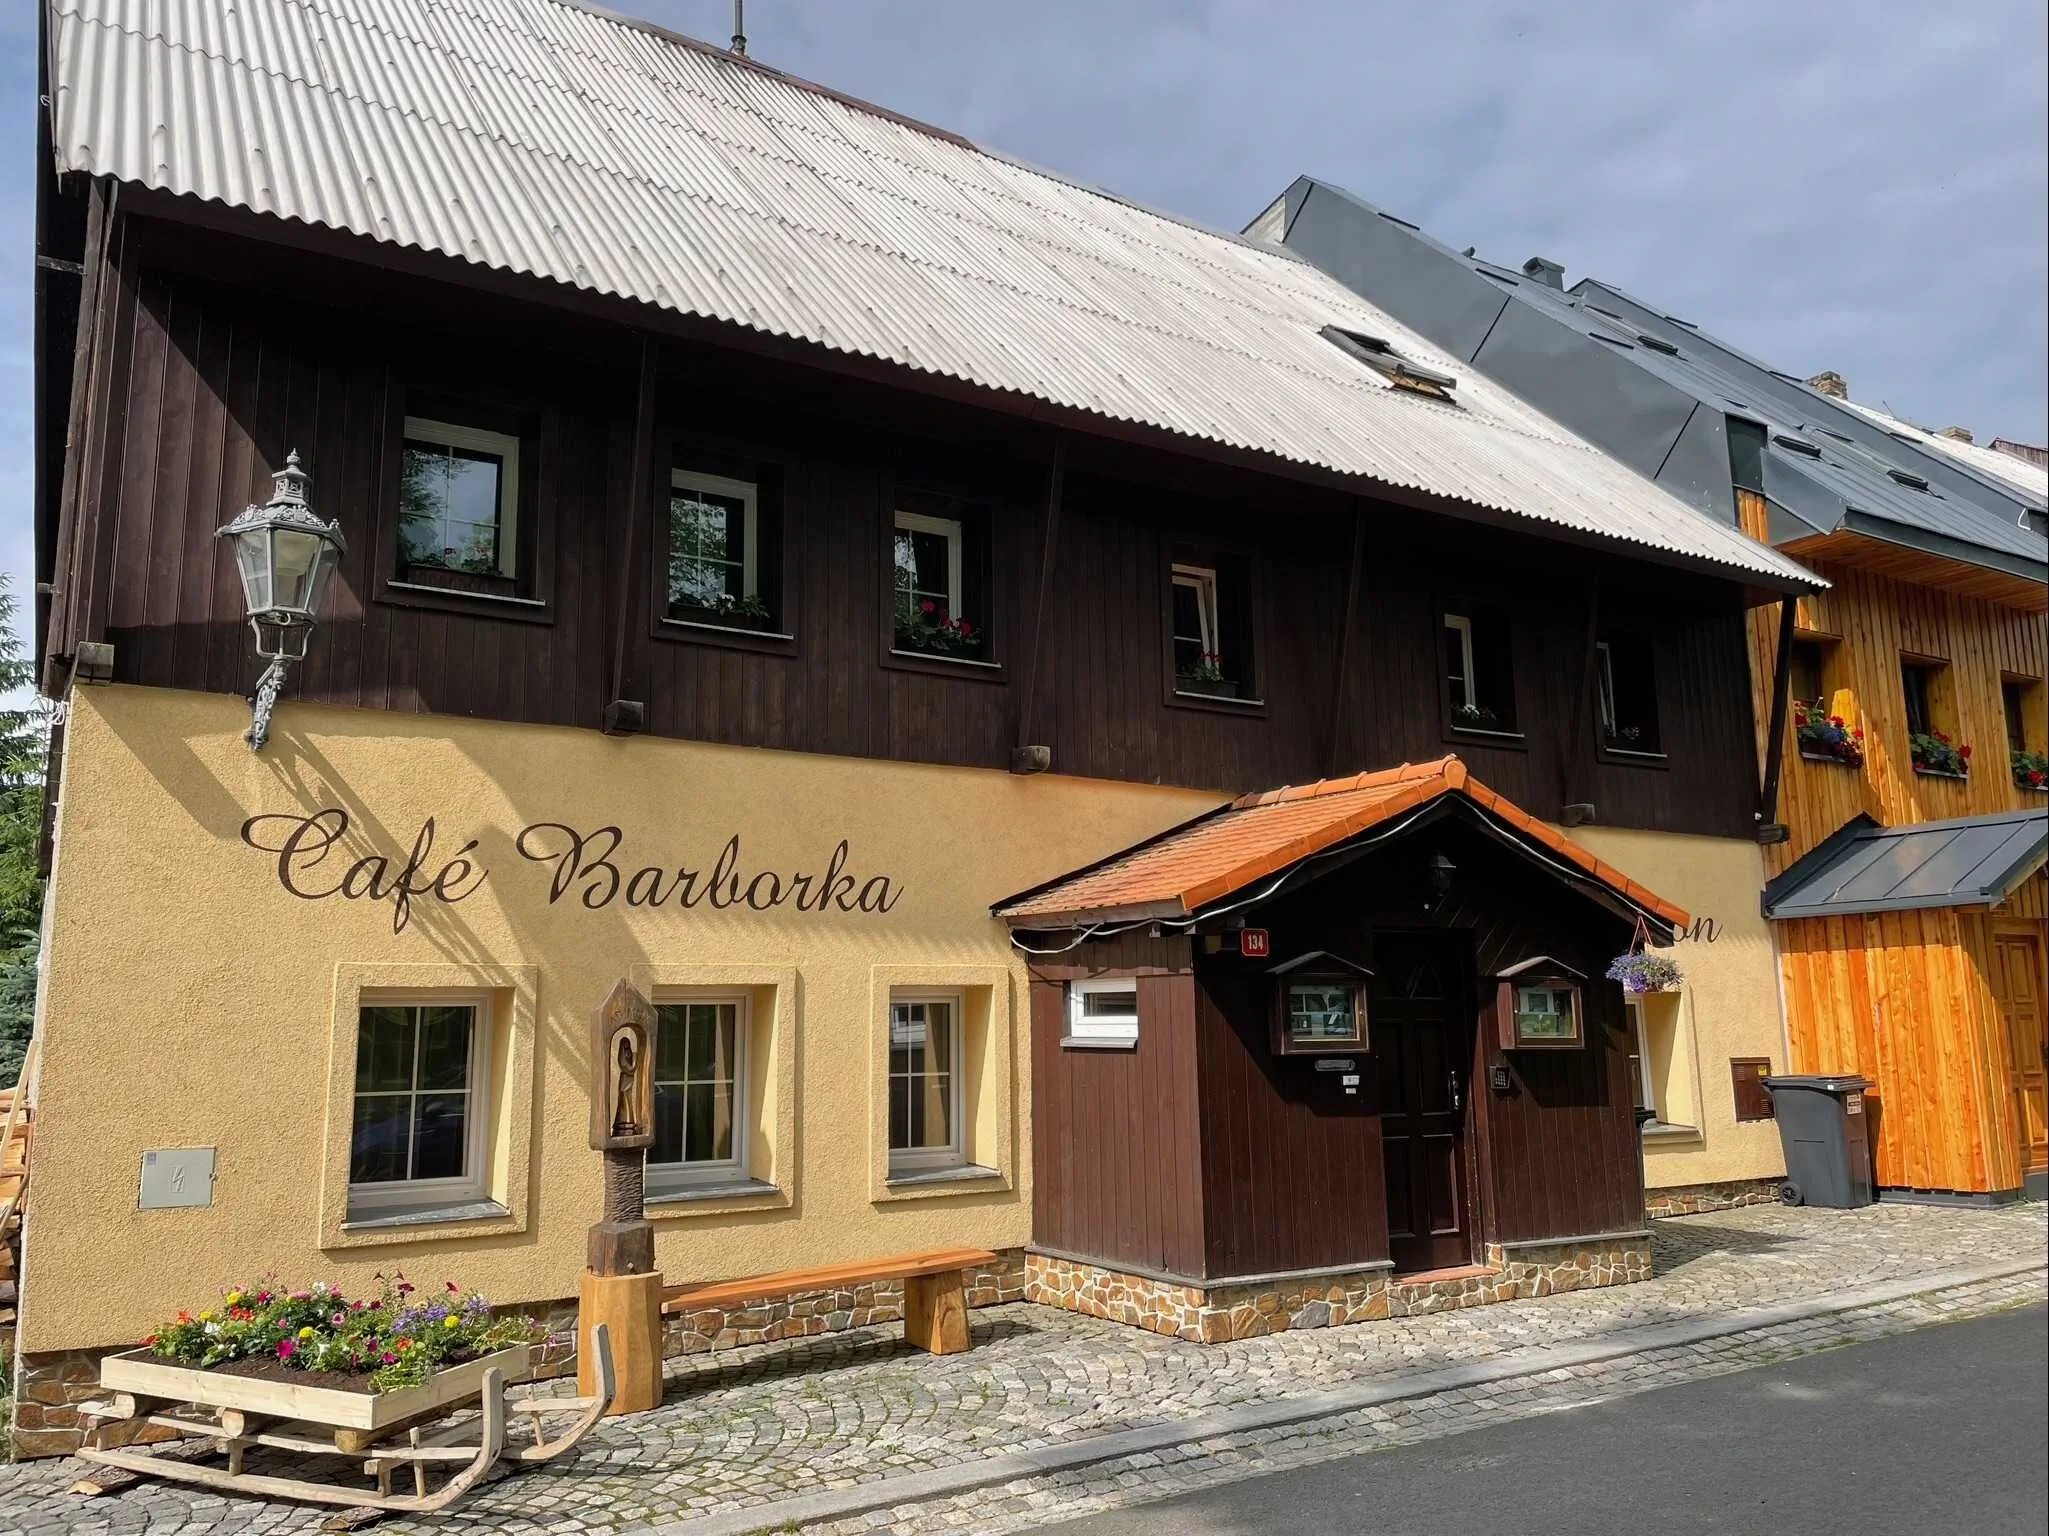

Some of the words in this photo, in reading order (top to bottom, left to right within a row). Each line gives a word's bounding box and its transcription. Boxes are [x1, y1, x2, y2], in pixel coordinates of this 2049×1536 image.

[241, 808, 488, 935] Café
[516, 823, 905, 914] Barborka
[1247, 934, 1264, 950] 134
